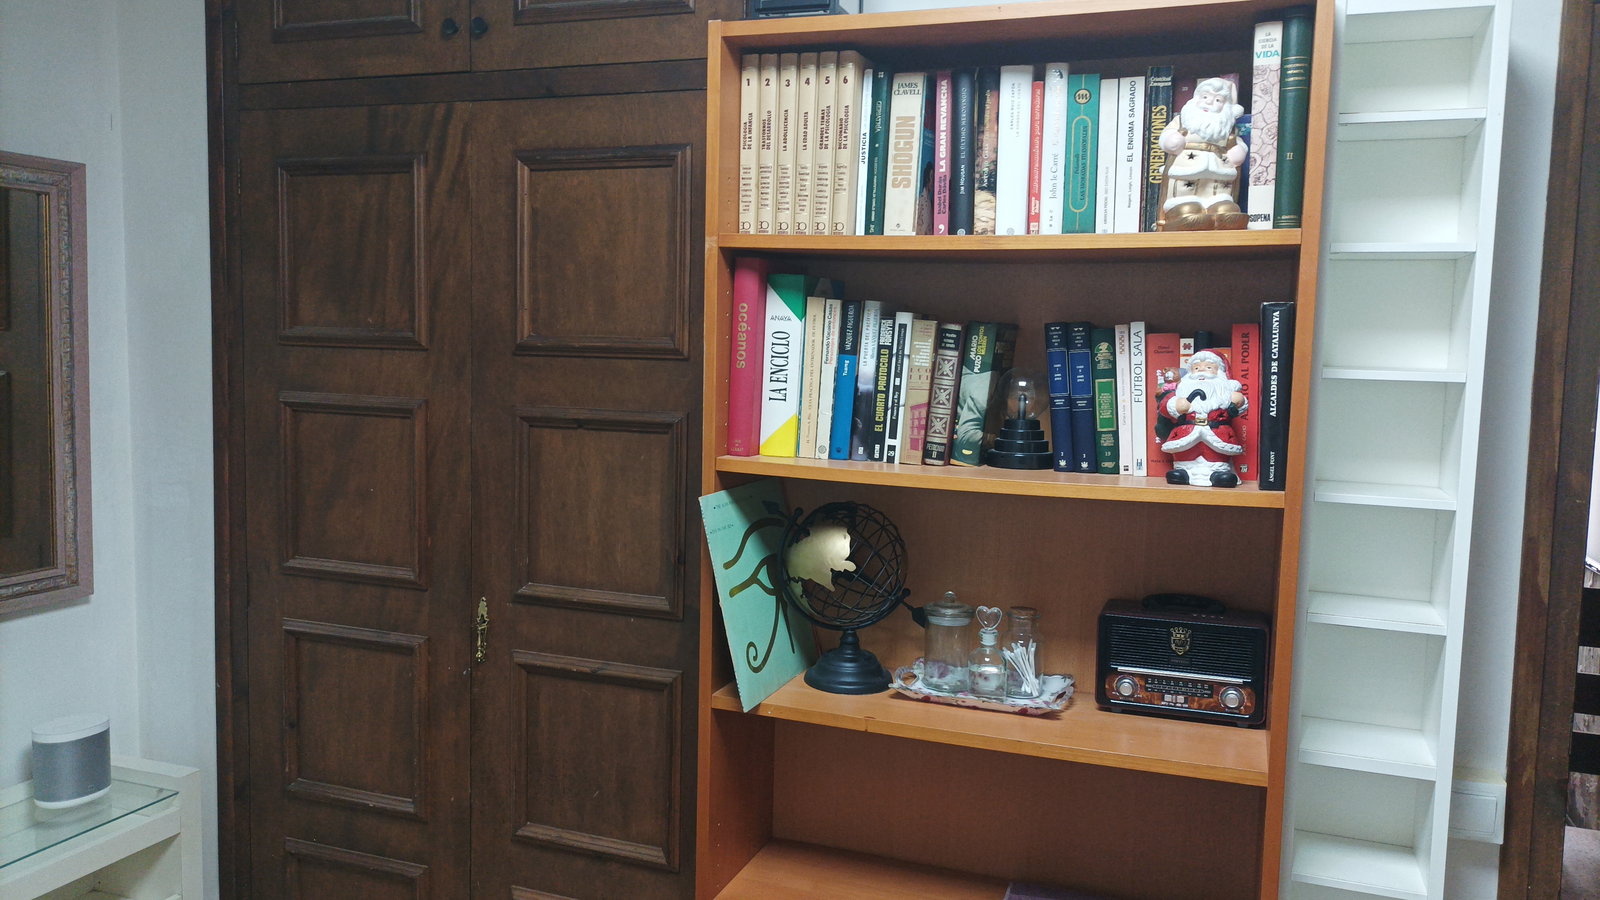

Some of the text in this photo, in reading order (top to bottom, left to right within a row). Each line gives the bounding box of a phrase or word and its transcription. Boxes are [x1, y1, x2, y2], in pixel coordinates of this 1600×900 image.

[1256, 50, 1280, 58] VIDA
[825, 76, 830, 84] 5
[1128, 81, 1136, 118] SAGRADO
[1150, 105, 1167, 184] GENERACIONES
[939, 160, 946, 172] LA
[1127, 153, 1133, 162] EL
[1049, 183, 1057, 199] John
[1249, 214, 1271, 222] SOPENA
[736, 303, 750, 368] océanos
[1271, 311, 1279, 358] CATALUNYA
[970, 335, 978, 360] MARIO
[769, 331, 790, 402] LA ENCICLO
[878, 349, 889, 390] PROTOCOLO
[974, 355, 982, 373] PUZO
[1132, 331, 1143, 403] FÚTBOL SALA
[1242, 368, 1249, 379] AL
[1271, 361, 1278, 372] DE
[875, 394, 886, 422] CUARTO
[1241, 384, 1249, 420] ATO
